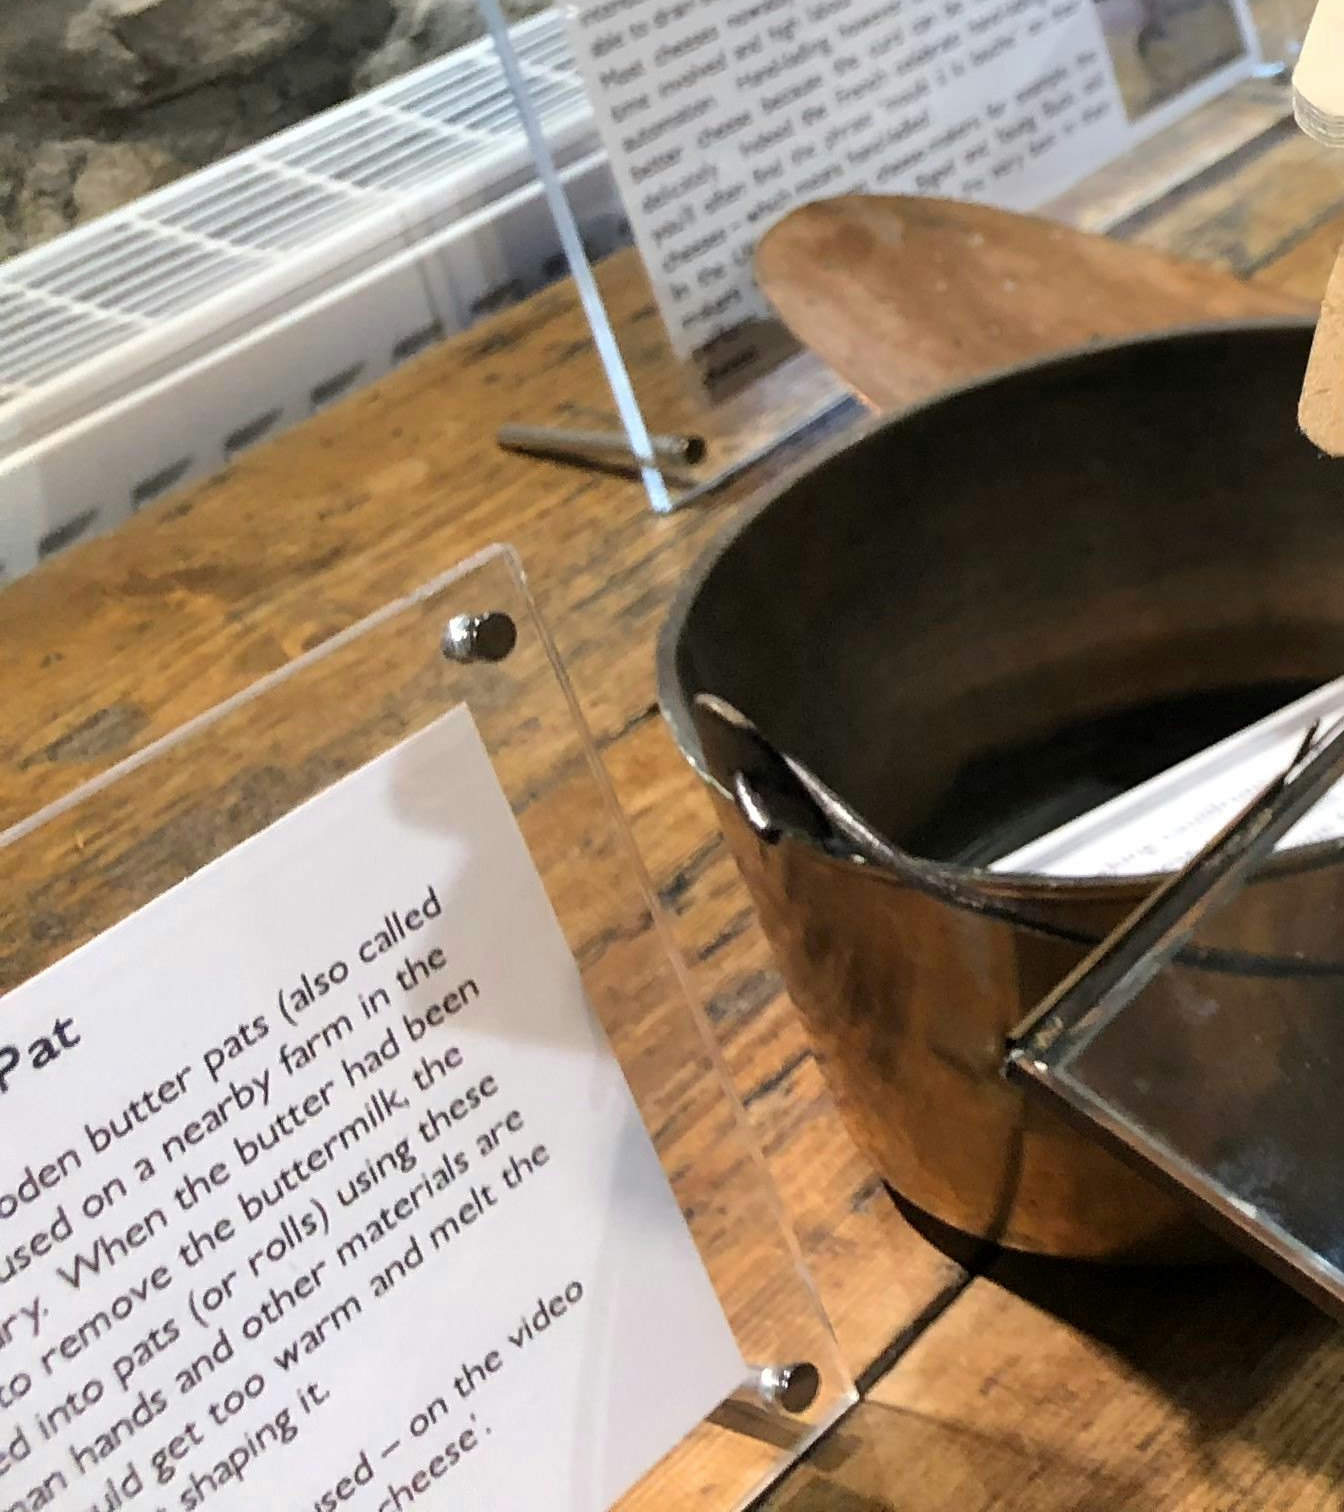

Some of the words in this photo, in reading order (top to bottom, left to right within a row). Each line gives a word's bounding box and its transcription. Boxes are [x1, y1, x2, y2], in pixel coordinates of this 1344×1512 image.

[55, 1207, 168, 1291] When
[173, 1161, 231, 1211] the
[232, 1079, 335, 1167] butter
[339, 1026, 401, 1089] had
[401, 978, 480, 1043] been
[81, 1176, 128, 1220] on
[132, 1156, 156, 1183] a
[161, 1067, 270, 1164] nearby
[278, 1014, 354, 1077] farm
[357, 987, 391, 1020] in
[395, 947, 447, 992] the
[83, 1064, 192, 1155] butter
[202, 1014, 270, 1085] pats
[277, 959, 349, 1027] (also
[357, 884, 442, 964] called
[0, 1372, 32, 1409] to
[39, 1264, 173, 1376] remove
[177, 1217, 236, 1268] the
[236, 1087, 410, 1224] buttermilk,
[411, 1046, 464, 1092] the
[34, 1378, 104, 1441] into
[111, 1317, 181, 1393] pats
[187, 1269, 237, 1329] (or
[246, 1197, 329, 1278] rolls)
[335, 1136, 418, 1207] using
[417, 1074, 499, 1144] these
[68, 1388, 168, 1475] hands
[174, 1327, 235, 1395] and
[241, 1259, 326, 1341] other
[335, 1151, 470, 1267] materials
[475, 1109, 524, 1158] are
[150, 1421, 205, 1485] get
[207, 1372, 266, 1427] too
[273, 1295, 362, 1372] warm
[369, 1233, 424, 1298] and
[428, 1184, 498, 1251] melt
[501, 1143, 550, 1190] the
[409, 1396, 449, 1438] on
[452, 1349, 503, 1399] the
[506, 1280, 584, 1349] video
[180, 1406, 299, 1507] shaping
[296, 1382, 331, 1415] it.
